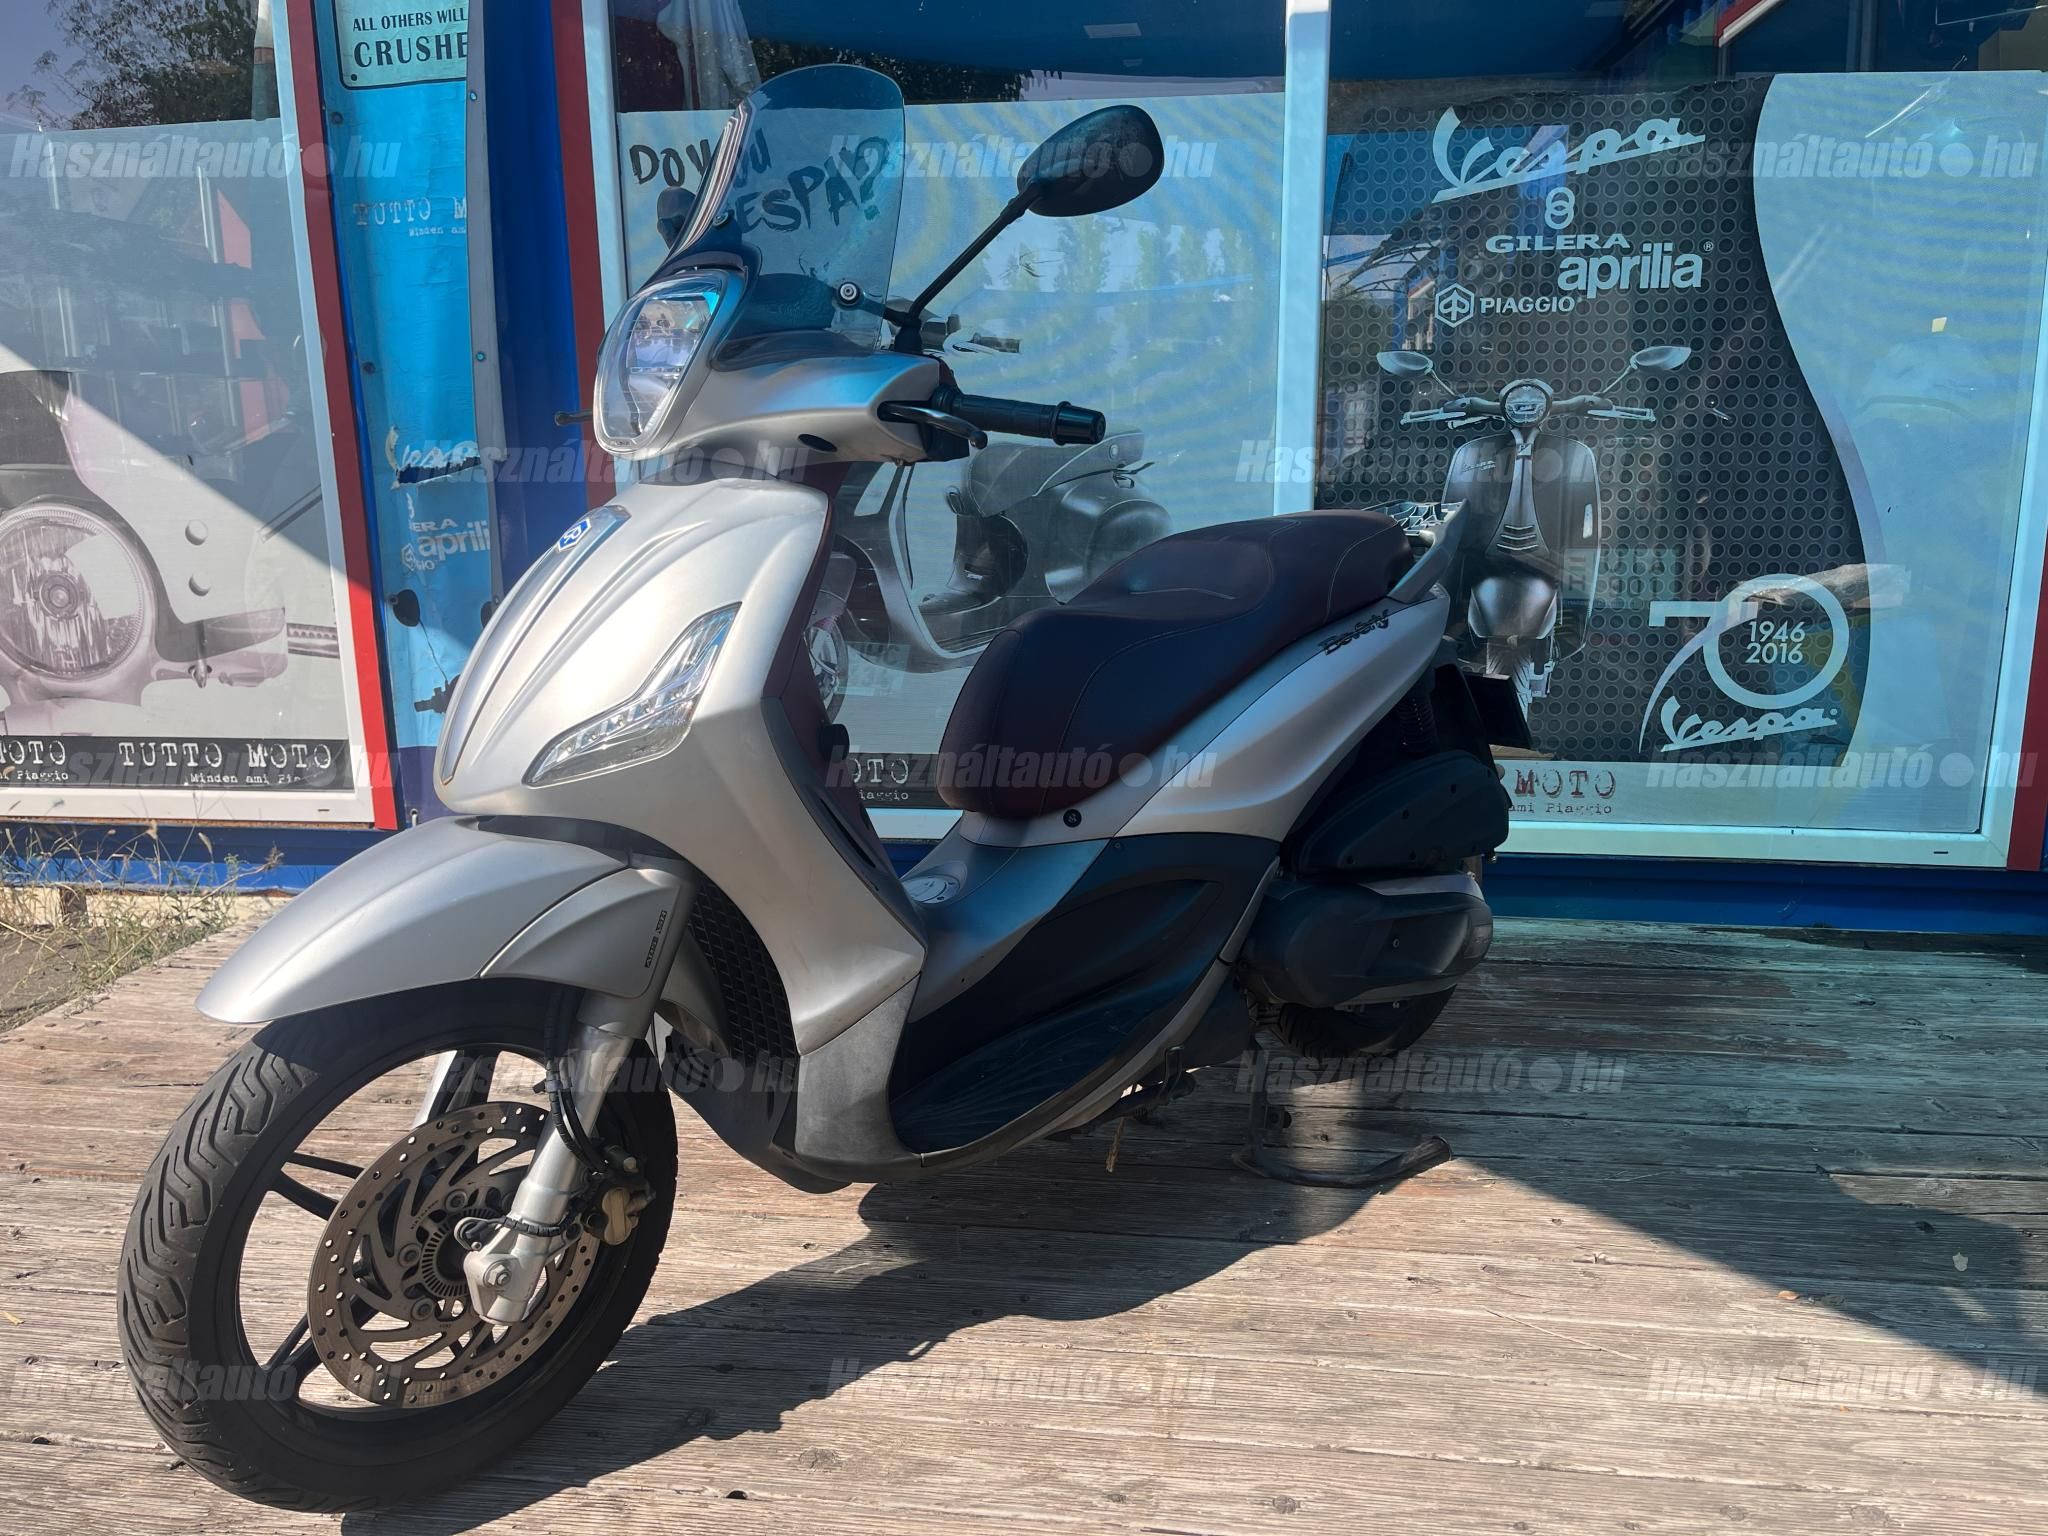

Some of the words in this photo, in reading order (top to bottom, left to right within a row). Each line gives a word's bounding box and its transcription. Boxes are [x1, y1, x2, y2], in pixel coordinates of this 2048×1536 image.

[353, 17, 377, 31] ALL
[381, 11, 432, 29] OTHERS
[437, 8, 467, 23] WILL
[1432, 106, 1705, 203] Vespa
[735, 136, 889, 233] ESPA?
[352, 197, 431, 225] TUTTO
[1486, 233, 1630, 253] GILERA
[1557, 243, 1703, 299] aprilia
[1480, 296, 1575, 313] PIAGGIO
[1748, 621, 1805, 642] 1946
[1745, 643, 1803, 664] 2016
[1660, 696, 1838, 753] Vespa
[119, 742, 222, 767] TUTTO
[246, 743, 331, 769] MOTO
[190, 773, 238, 784] Minden
[1515, 768, 1617, 798] MOTO
[1545, 802, 1612, 815] Piaggio
